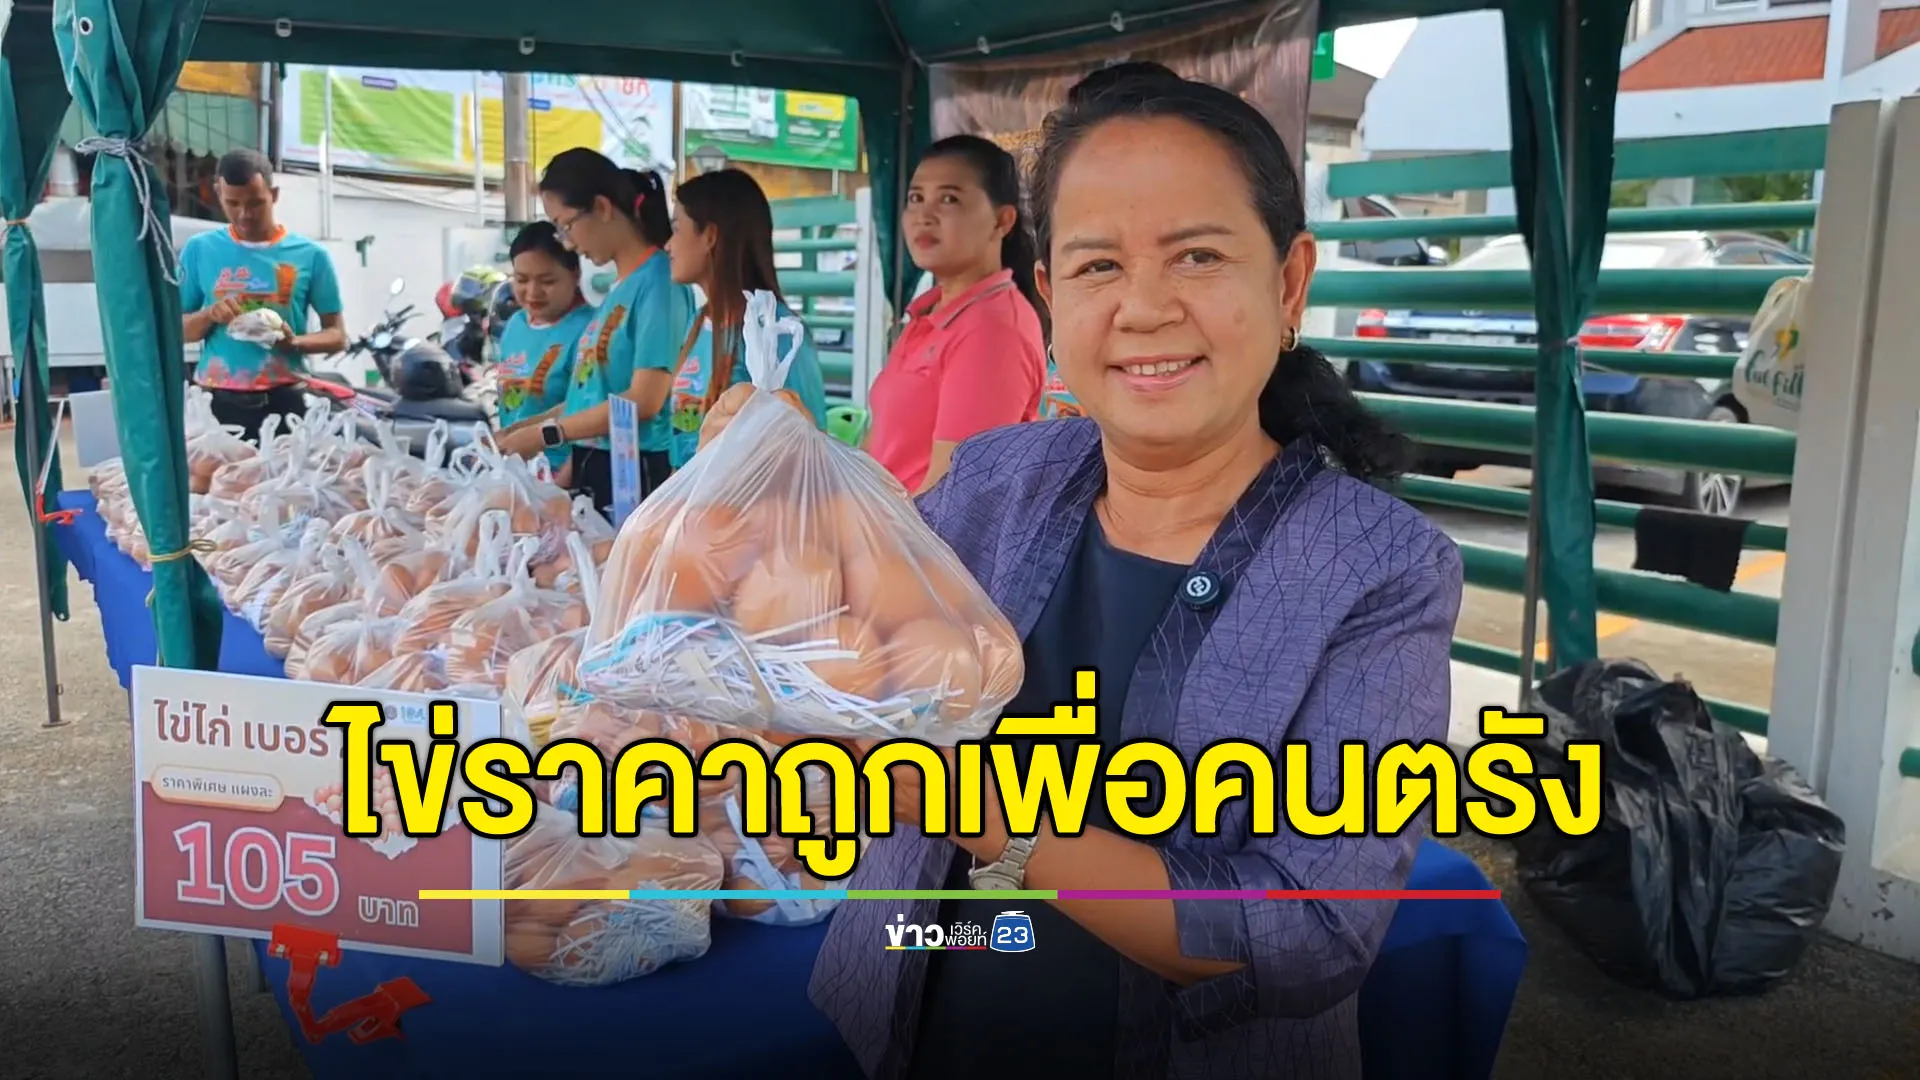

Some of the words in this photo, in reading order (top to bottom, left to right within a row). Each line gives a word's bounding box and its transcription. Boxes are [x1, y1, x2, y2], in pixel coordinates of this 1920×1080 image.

[154, 699, 231, 747] ไข่ไก่
[244, 717, 329, 757] เบอร
[162, 775, 227, 794] ราคาพิเศษ
[231, 781, 274, 798] แผงละ
[173, 820, 340, 916] 105
[358, 895, 419, 927] บาท
